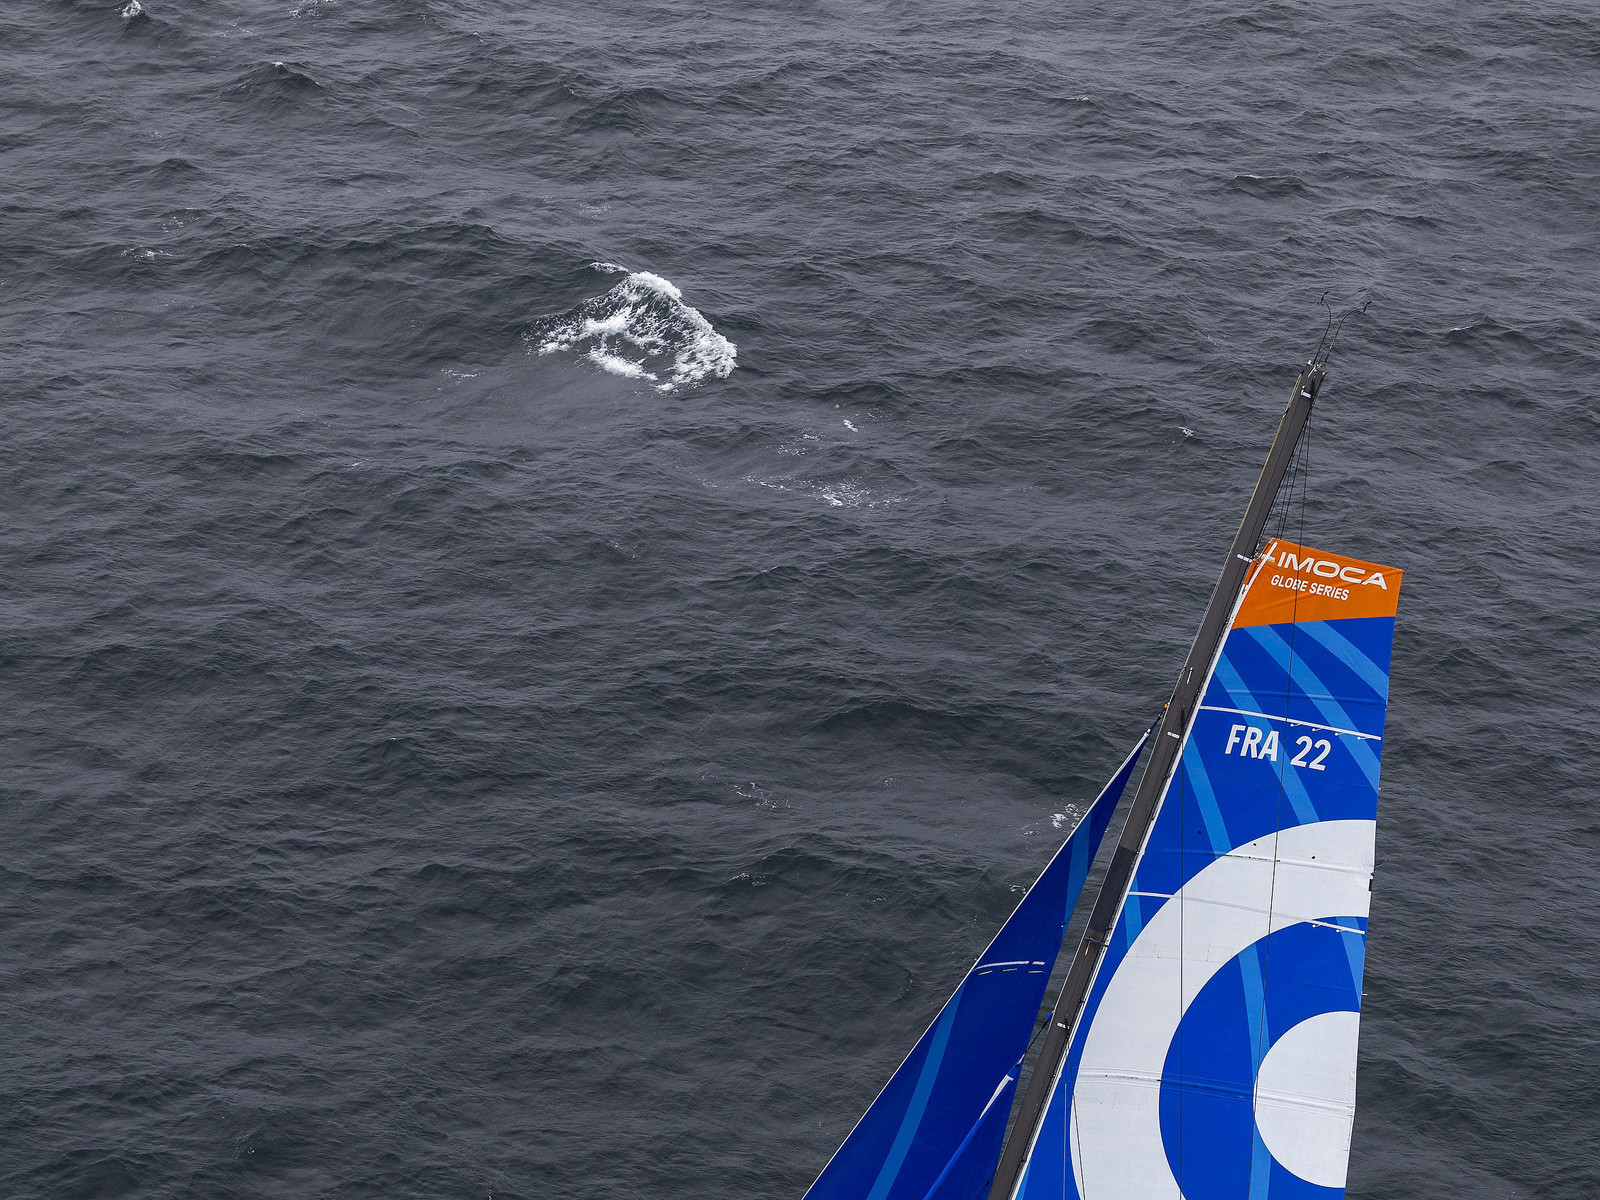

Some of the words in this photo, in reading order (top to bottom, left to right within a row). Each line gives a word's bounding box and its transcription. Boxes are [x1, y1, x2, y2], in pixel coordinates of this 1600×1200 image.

[1271, 574, 1307, 592] GLOBE
[1309, 582, 1349, 600] SERIES
[1278, 552, 1387, 590] IMOCA
[1225, 724, 1279, 762] FRA
[1290, 736, 1331, 771] 22
